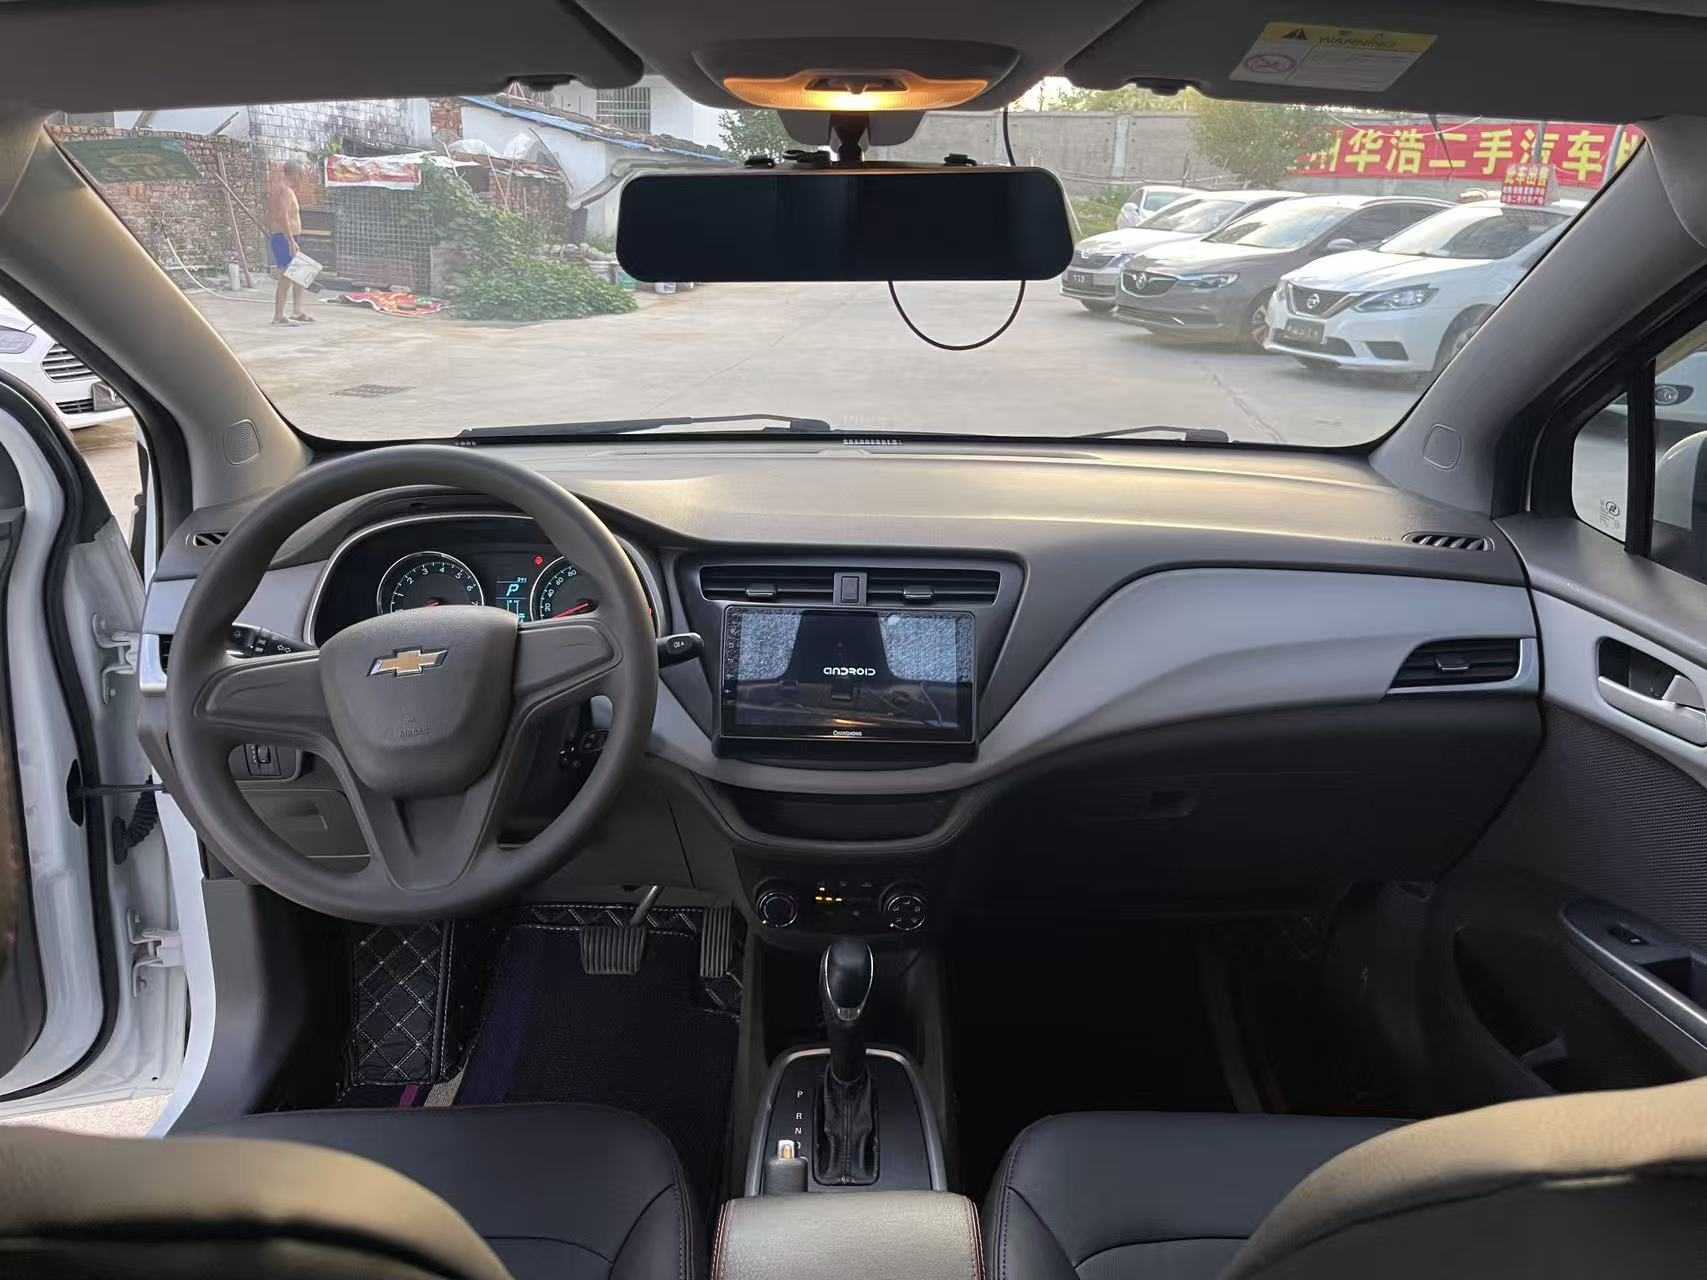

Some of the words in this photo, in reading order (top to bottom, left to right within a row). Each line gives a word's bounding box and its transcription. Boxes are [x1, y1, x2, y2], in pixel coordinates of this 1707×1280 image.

[421, 568, 429, 576] 3
[506, 583, 520, 597] P
[797, 1090, 804, 1098] P
[795, 1112, 802, 1120] R
